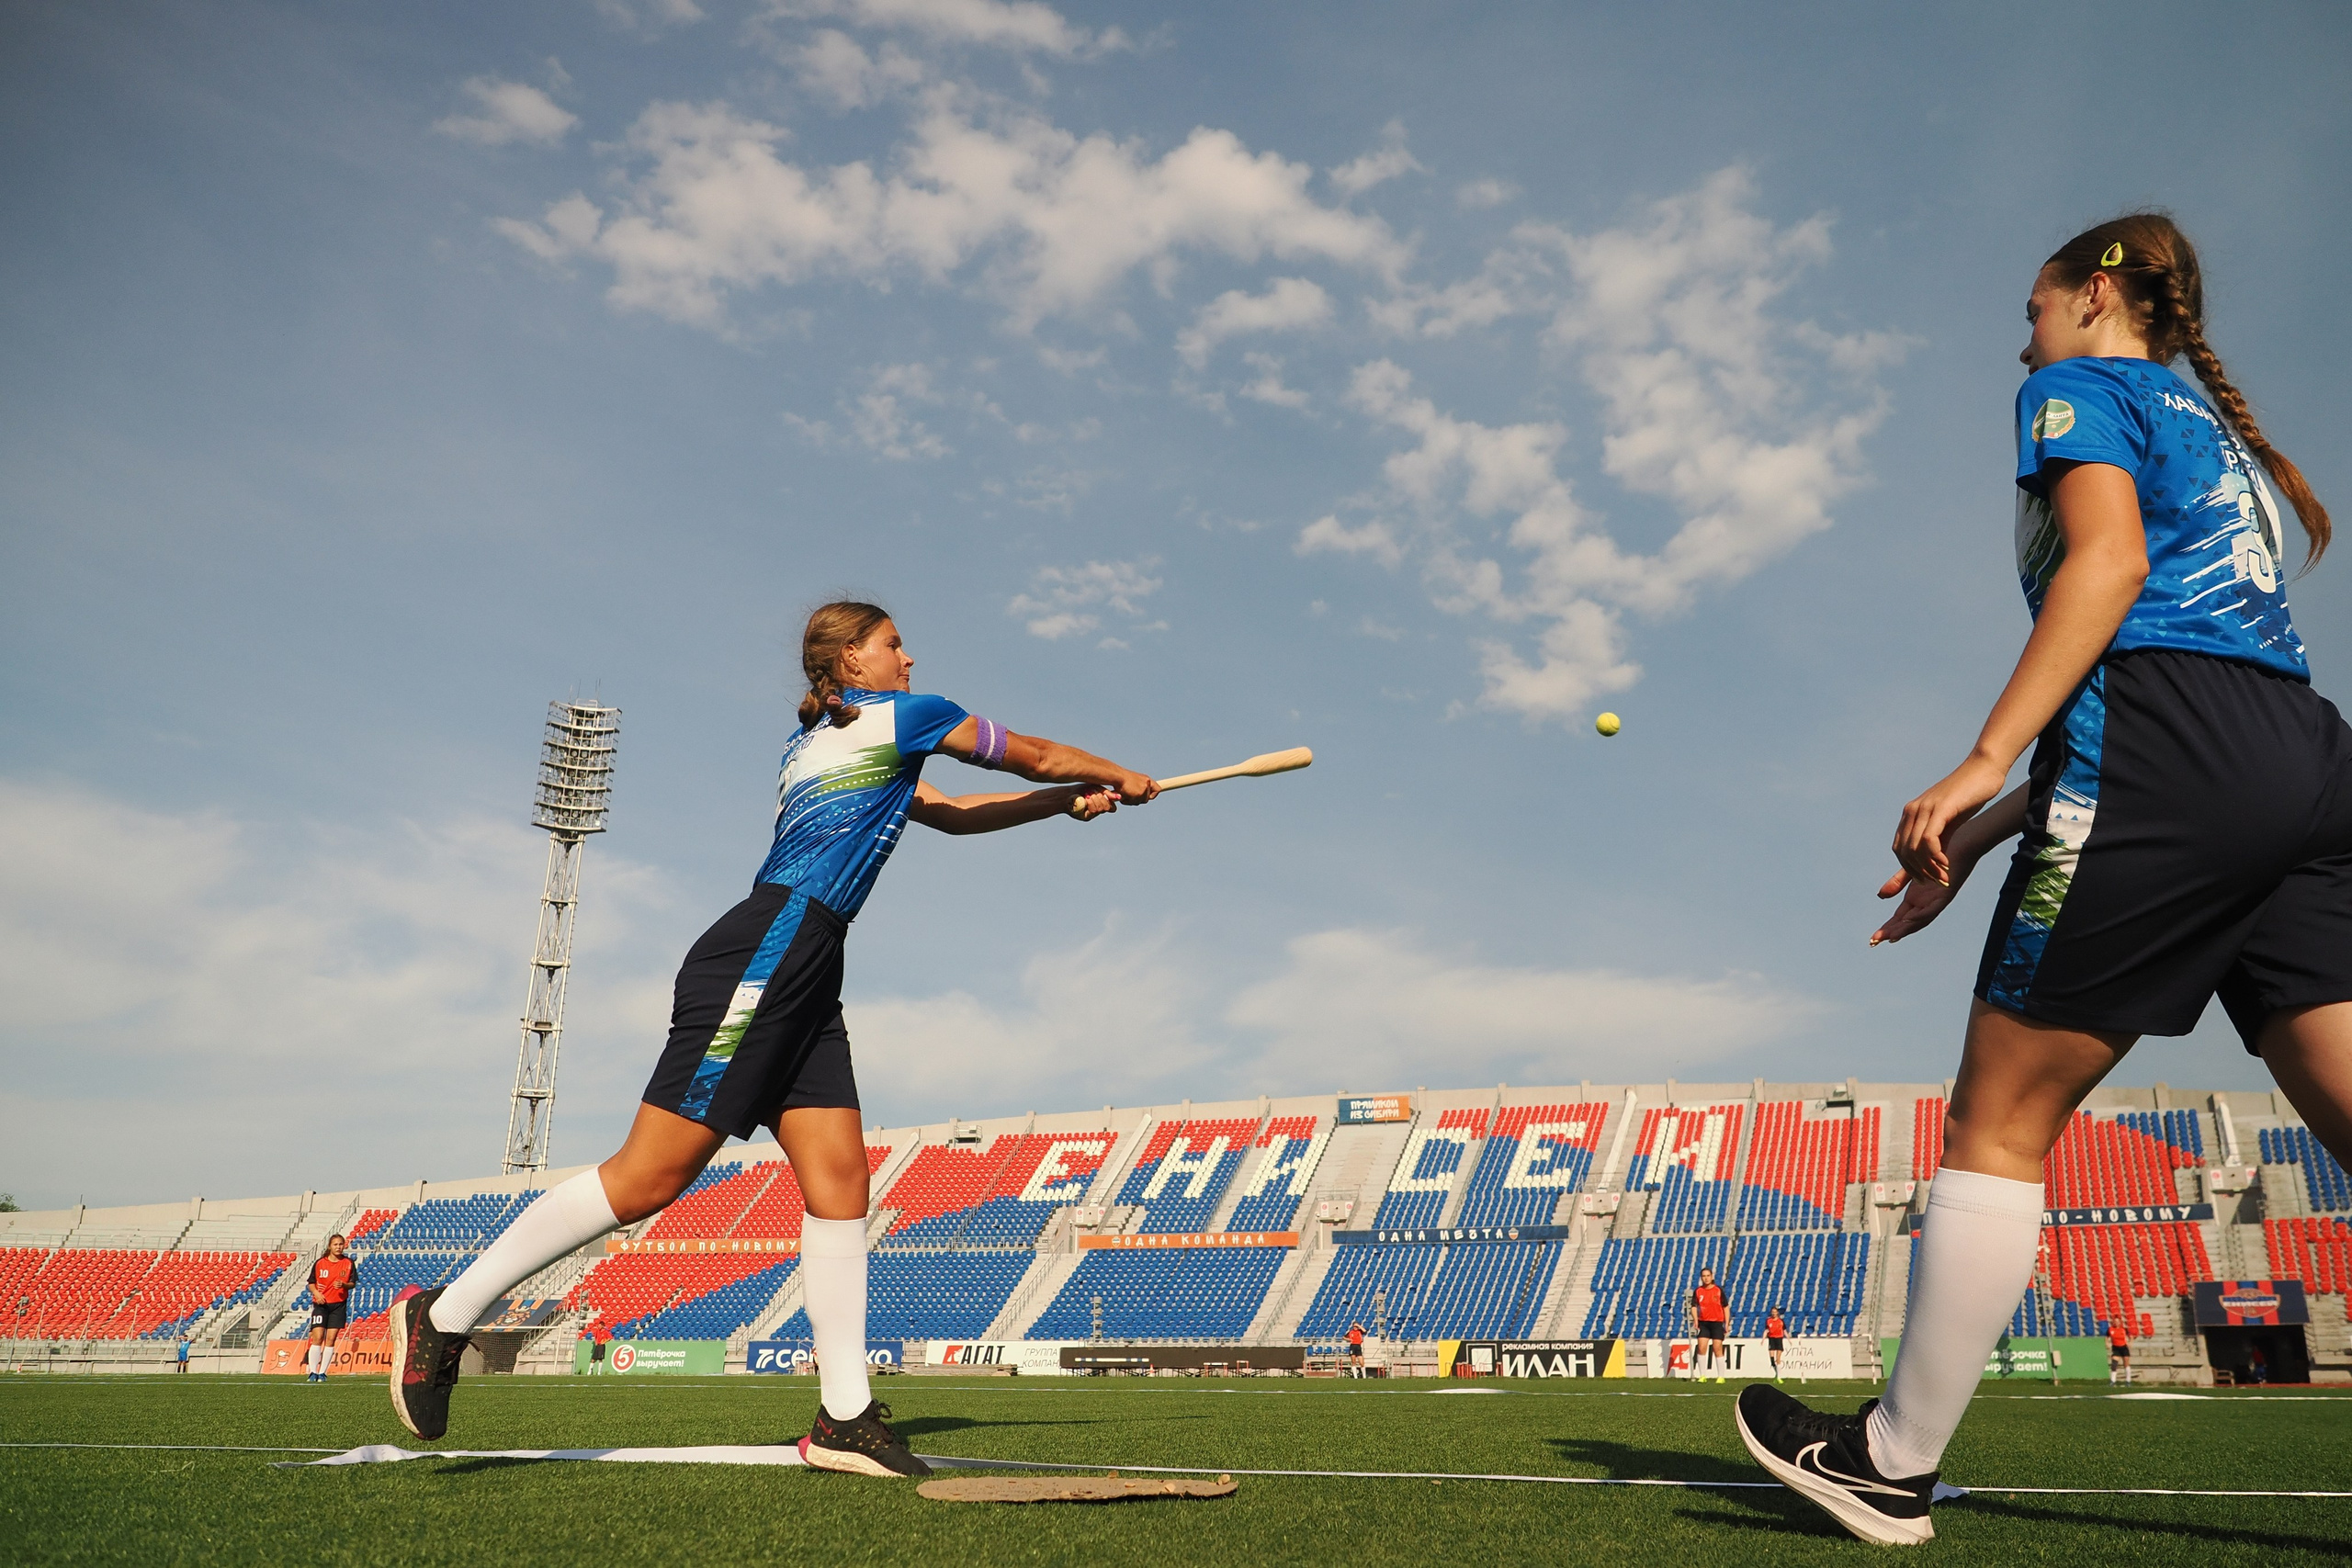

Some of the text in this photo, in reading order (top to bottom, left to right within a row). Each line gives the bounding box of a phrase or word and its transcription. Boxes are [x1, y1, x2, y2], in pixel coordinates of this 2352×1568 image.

[1351, 1099, 1398, 1110] ПРЯМИКОМ
[1350, 1109, 1399, 1119] ИЗ СИБИРИ
[1125, 1234, 1264, 1247] ОДНА КОМАНДА
[1378, 1228, 1503, 1242] ОДНА МЕЧТА
[619, 1241, 797, 1252] ФУТБОЛ ПО-НОВОМУ
[319, 1269, 328, 1279] 10
[312, 1315, 322, 1325] 10
[1501, 1342, 1594, 1351] рекламная компания
[638, 1349, 686, 1359] Пятёрочка
[960, 1345, 1005, 1365] АГАТ
[1024, 1348, 1057, 1357] ГРУППА
[1785, 1347, 1814, 1358] УППА
[1991, 1348, 2047, 1361] тёрочка
[356, 1352, 392, 1367] ПИЦ
[636, 1359, 684, 1369] выручает!
[1022, 1359, 1059, 1368] КОМПАН
[1502, 1353, 1595, 1378] ИЛАН
[1984, 1362, 2048, 1373] ыручает!
